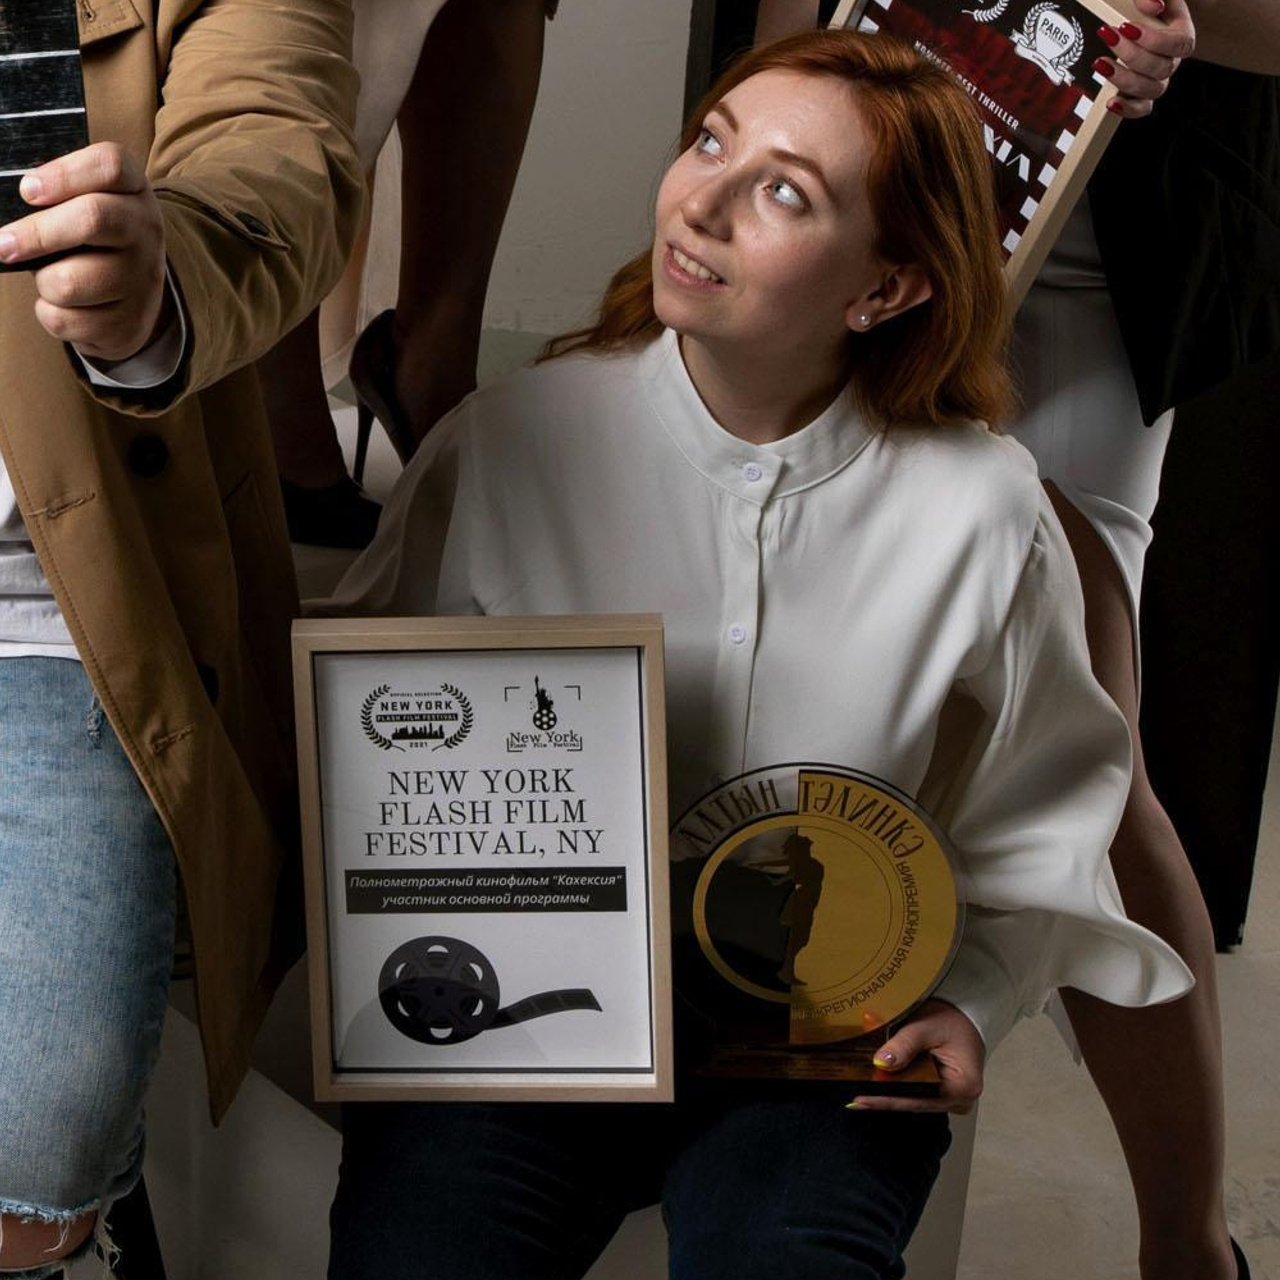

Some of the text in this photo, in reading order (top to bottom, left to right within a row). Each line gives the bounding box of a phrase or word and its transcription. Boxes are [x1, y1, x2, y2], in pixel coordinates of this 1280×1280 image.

[1041, 18, 1070, 46] PARIS
[978, 92, 1019, 131] THRILLER
[381, 700, 453, 711] NEW YORK
[422, 713, 458, 721] FESTIVAL
[510, 730, 579, 743] New York
[387, 768, 575, 795] NEW YORK
[378, 798, 588, 826] FLASH FILM
[364, 829, 605, 859] FESTIVAL, NY
[350, 874, 623, 889] Полнометражный кинофильм "Кахексия"
[381, 892, 590, 907] участник основной программы
[897, 860, 922, 947] КИНОПРЕМИЯ
